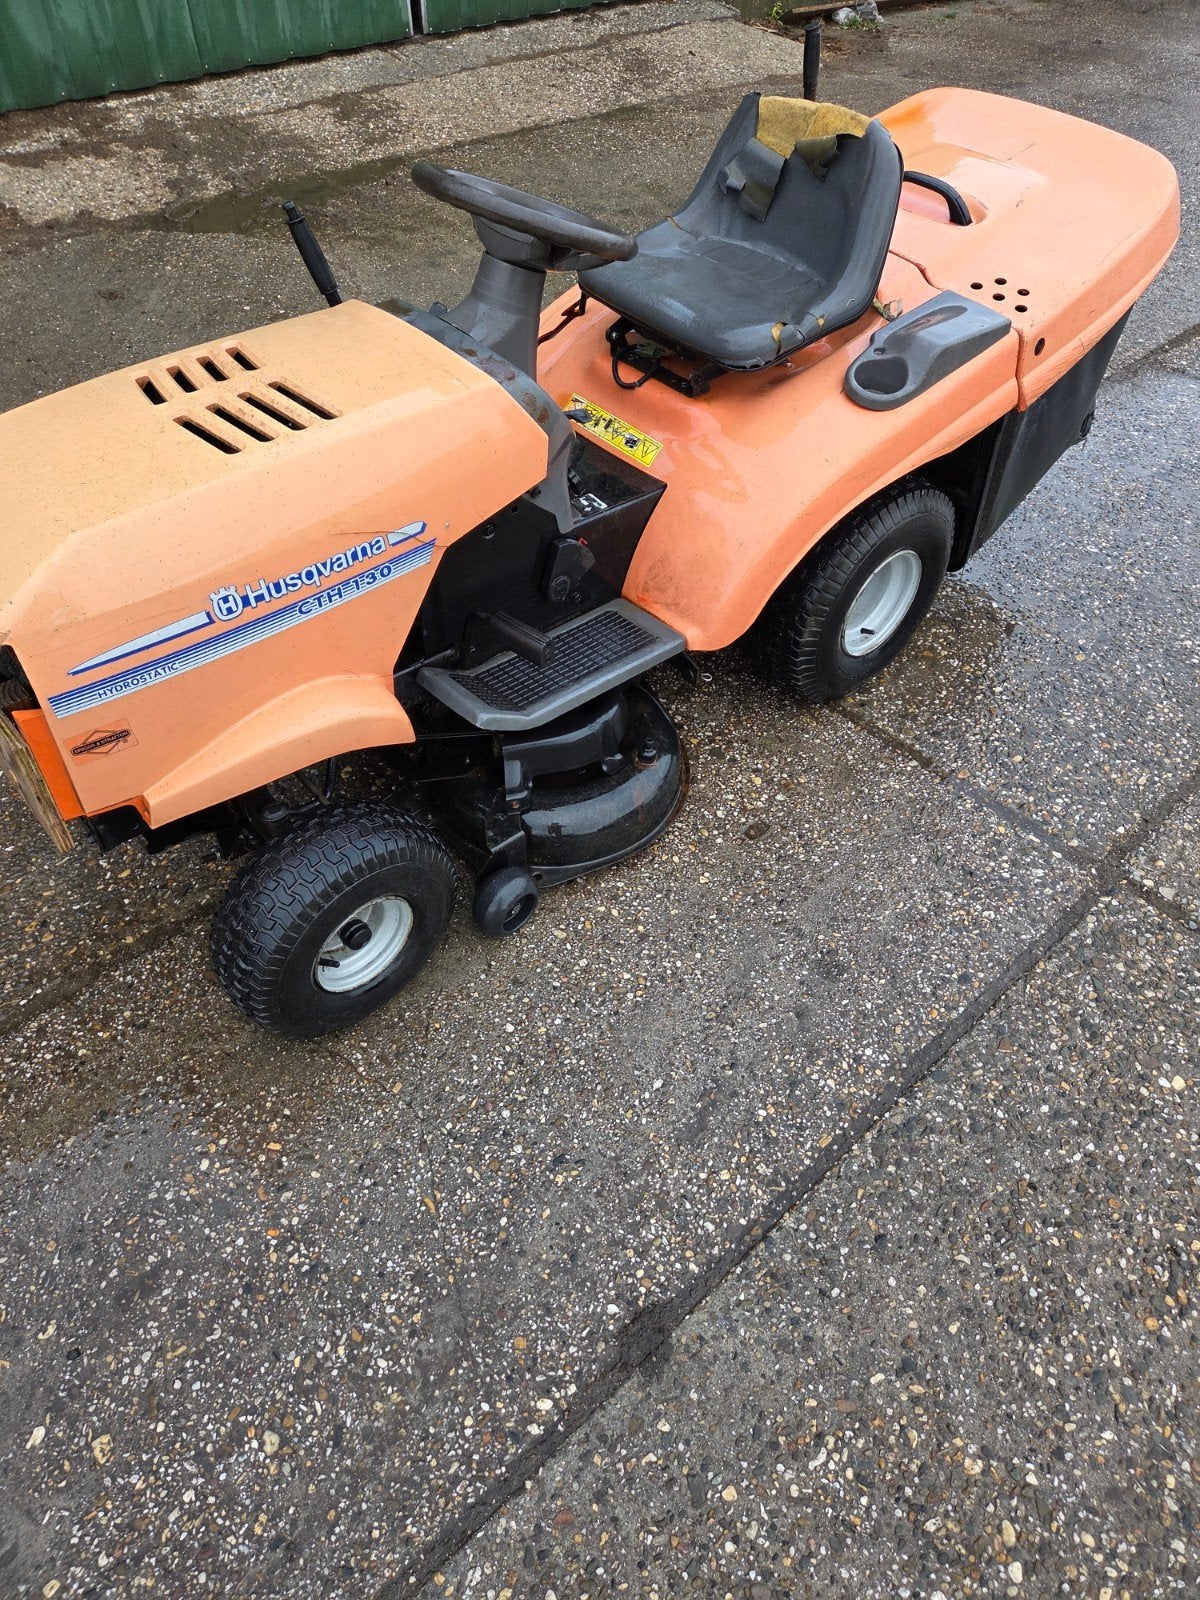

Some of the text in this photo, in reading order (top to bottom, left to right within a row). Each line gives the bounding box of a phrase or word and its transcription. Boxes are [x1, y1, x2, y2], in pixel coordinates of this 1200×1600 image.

[245, 535, 388, 608] Husqvarna
[297, 564, 393, 616] CTH 130
[97, 662, 179, 699] HYDROSTATIC
